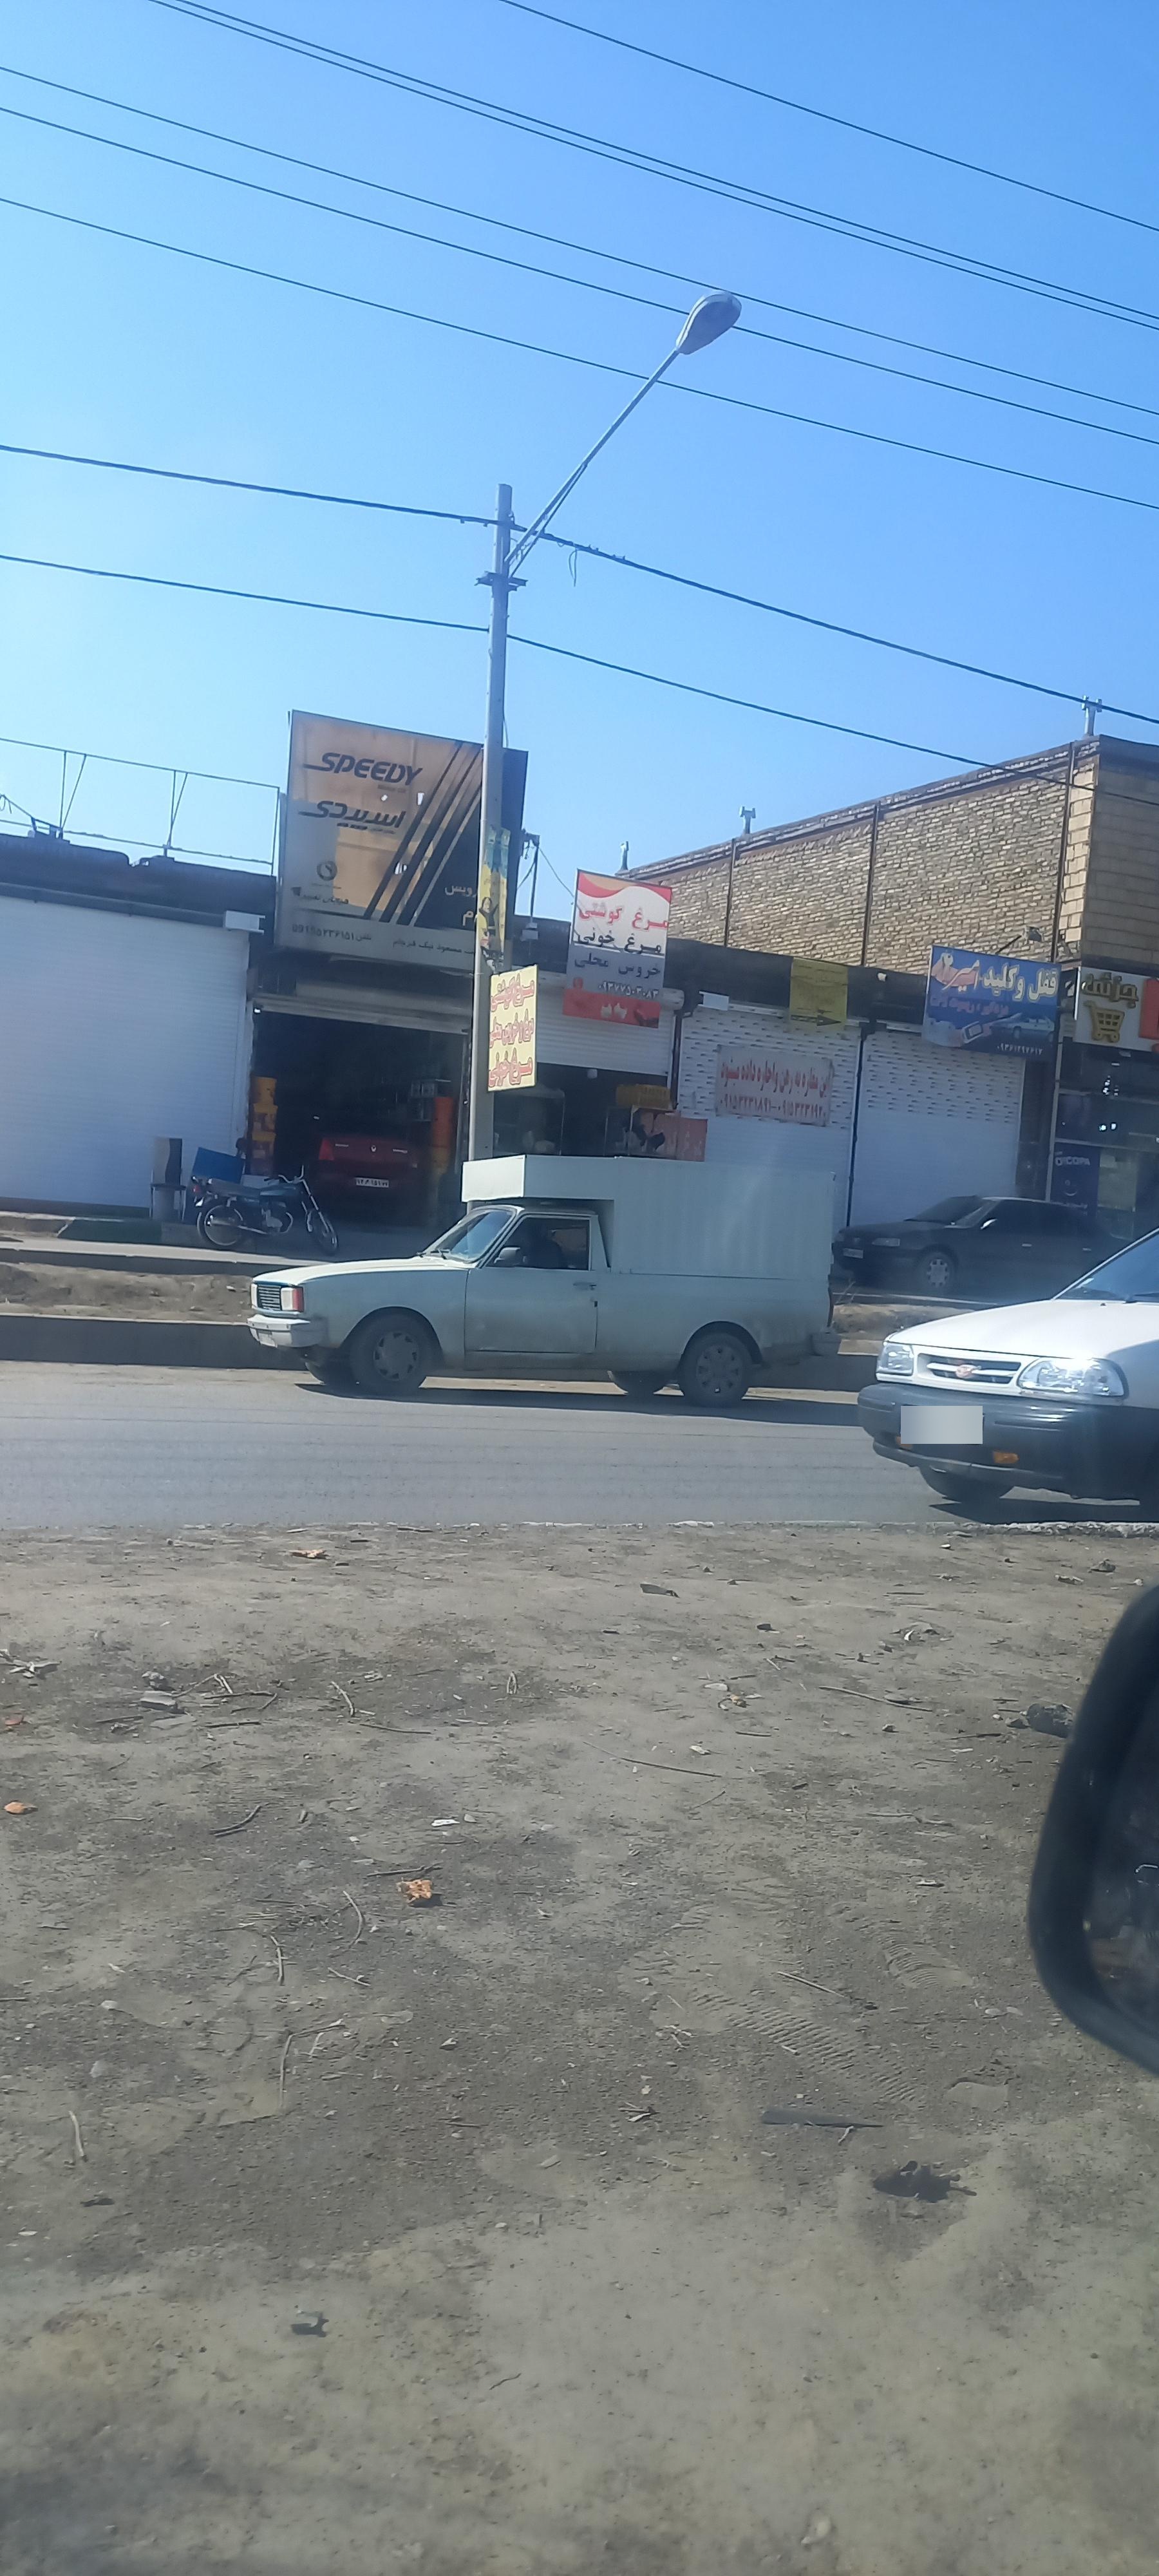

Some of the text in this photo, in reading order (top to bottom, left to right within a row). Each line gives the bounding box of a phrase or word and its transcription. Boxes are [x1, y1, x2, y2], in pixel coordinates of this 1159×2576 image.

[303, 752, 423, 786] SPEEDY
[579, 902, 670, 931] مرغ گوشتی
[577, 927, 661, 953] مرغ خونی
[574, 952, 660, 979] خروس محلی
[513, 973, 535, 1007] مرغ
[1028, 967, 1059, 1003] قفل
[510, 1047, 533, 1086] مرغ
